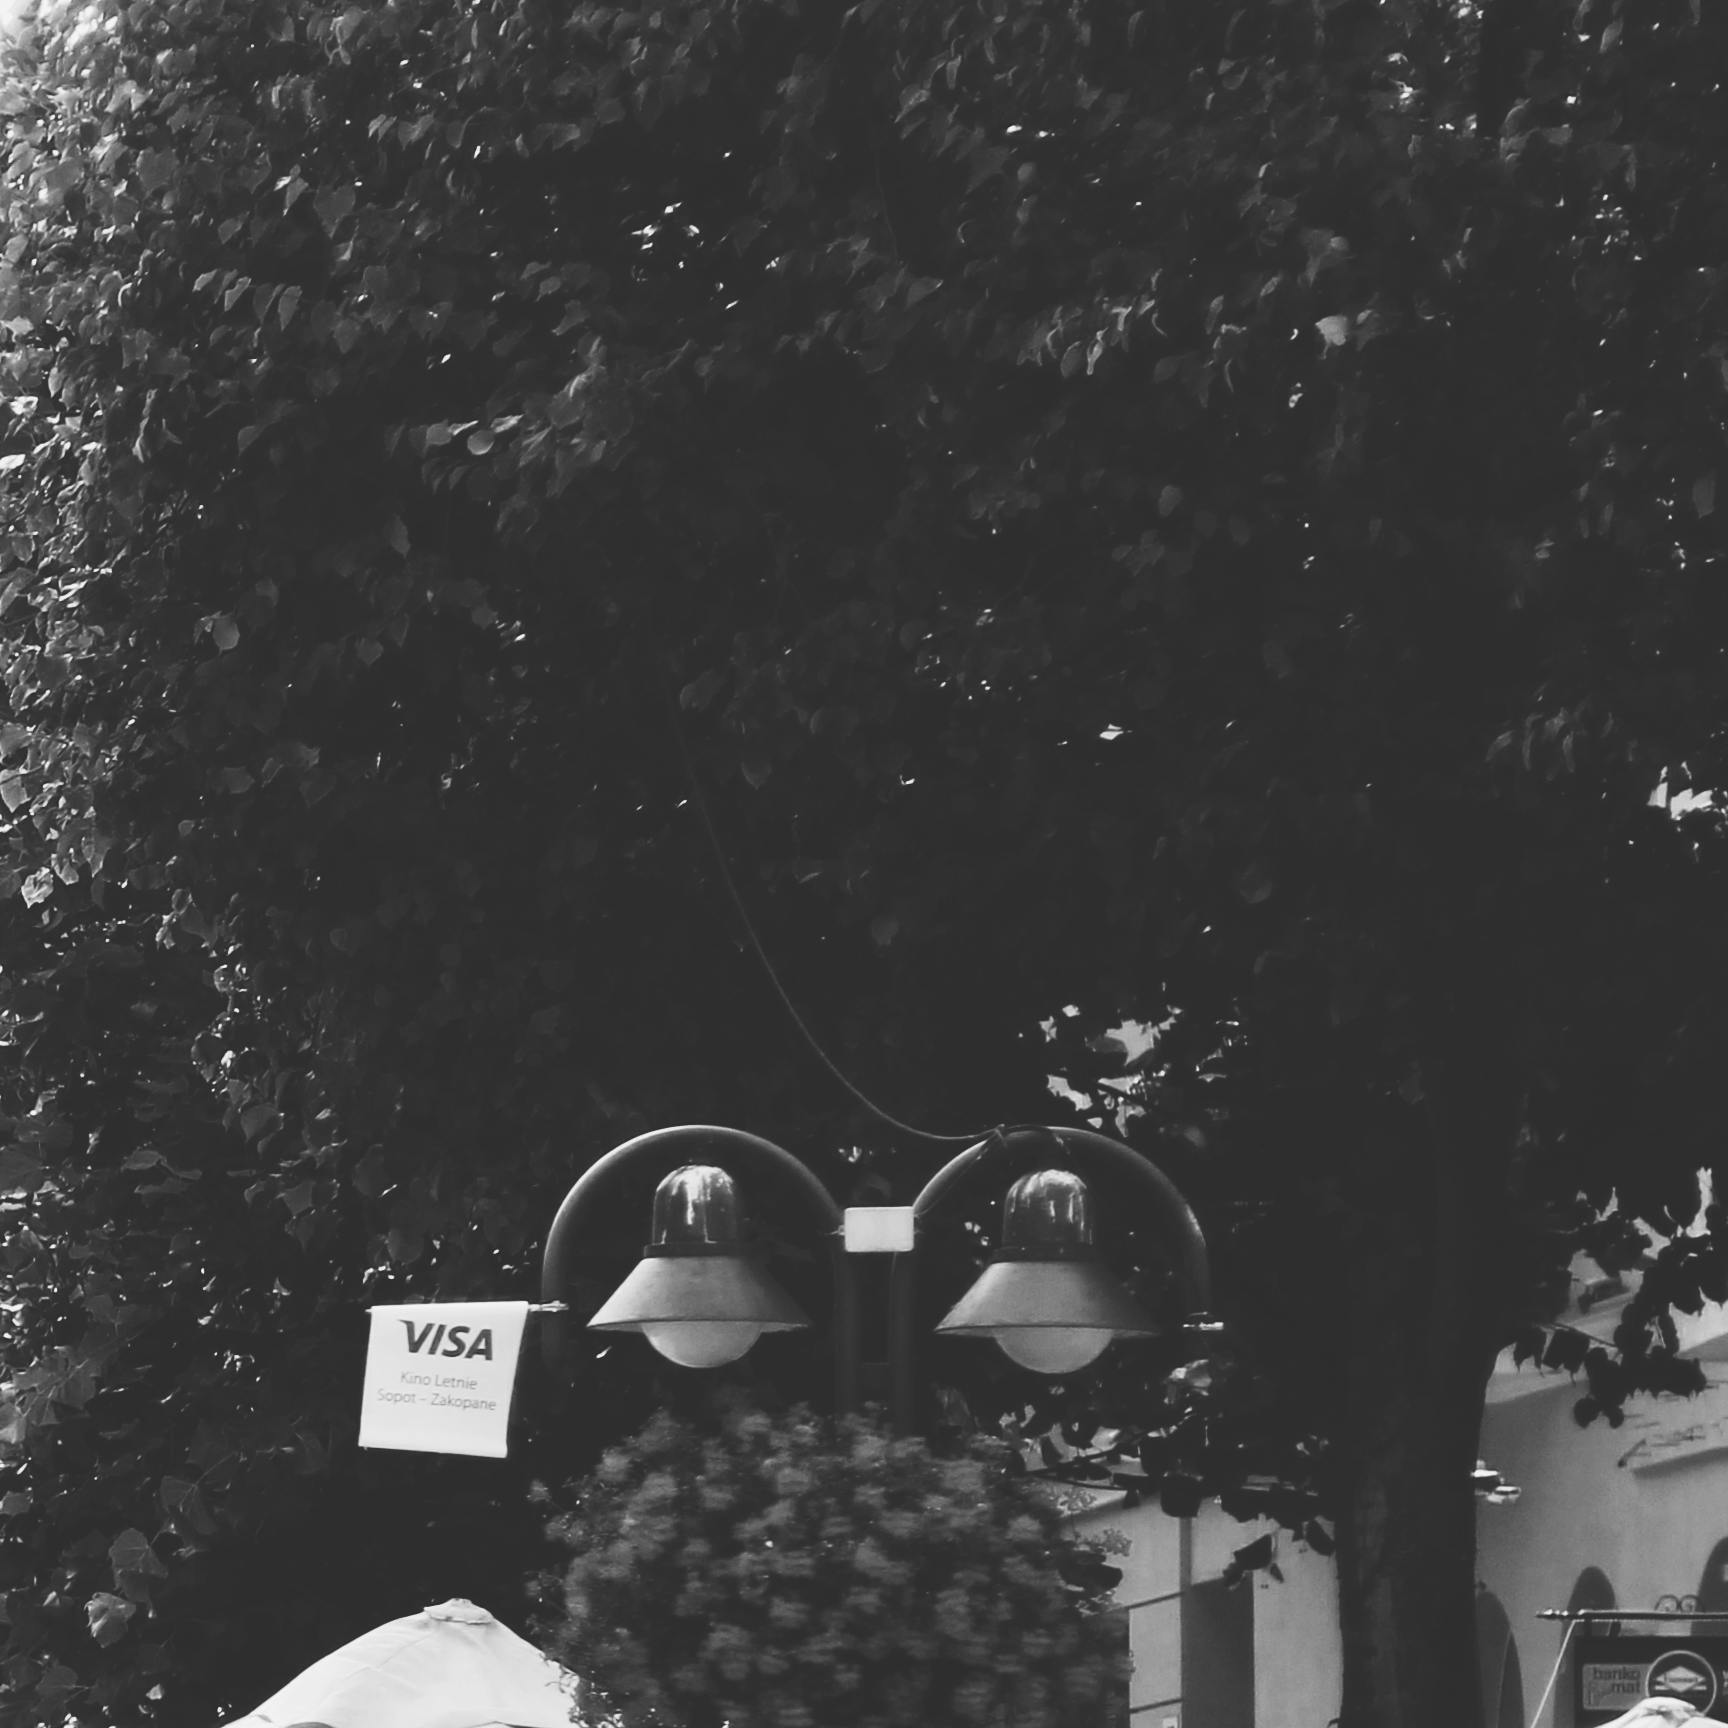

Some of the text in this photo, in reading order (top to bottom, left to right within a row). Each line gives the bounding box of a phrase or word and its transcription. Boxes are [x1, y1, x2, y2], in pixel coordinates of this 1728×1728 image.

[398, 1319, 493, 1361] VISA
[401, 1371, 477, 1390] Kino Letnie
[377, 1388, 417, 1406] Sopot
[431, 1393, 497, 1411] Zakopane
